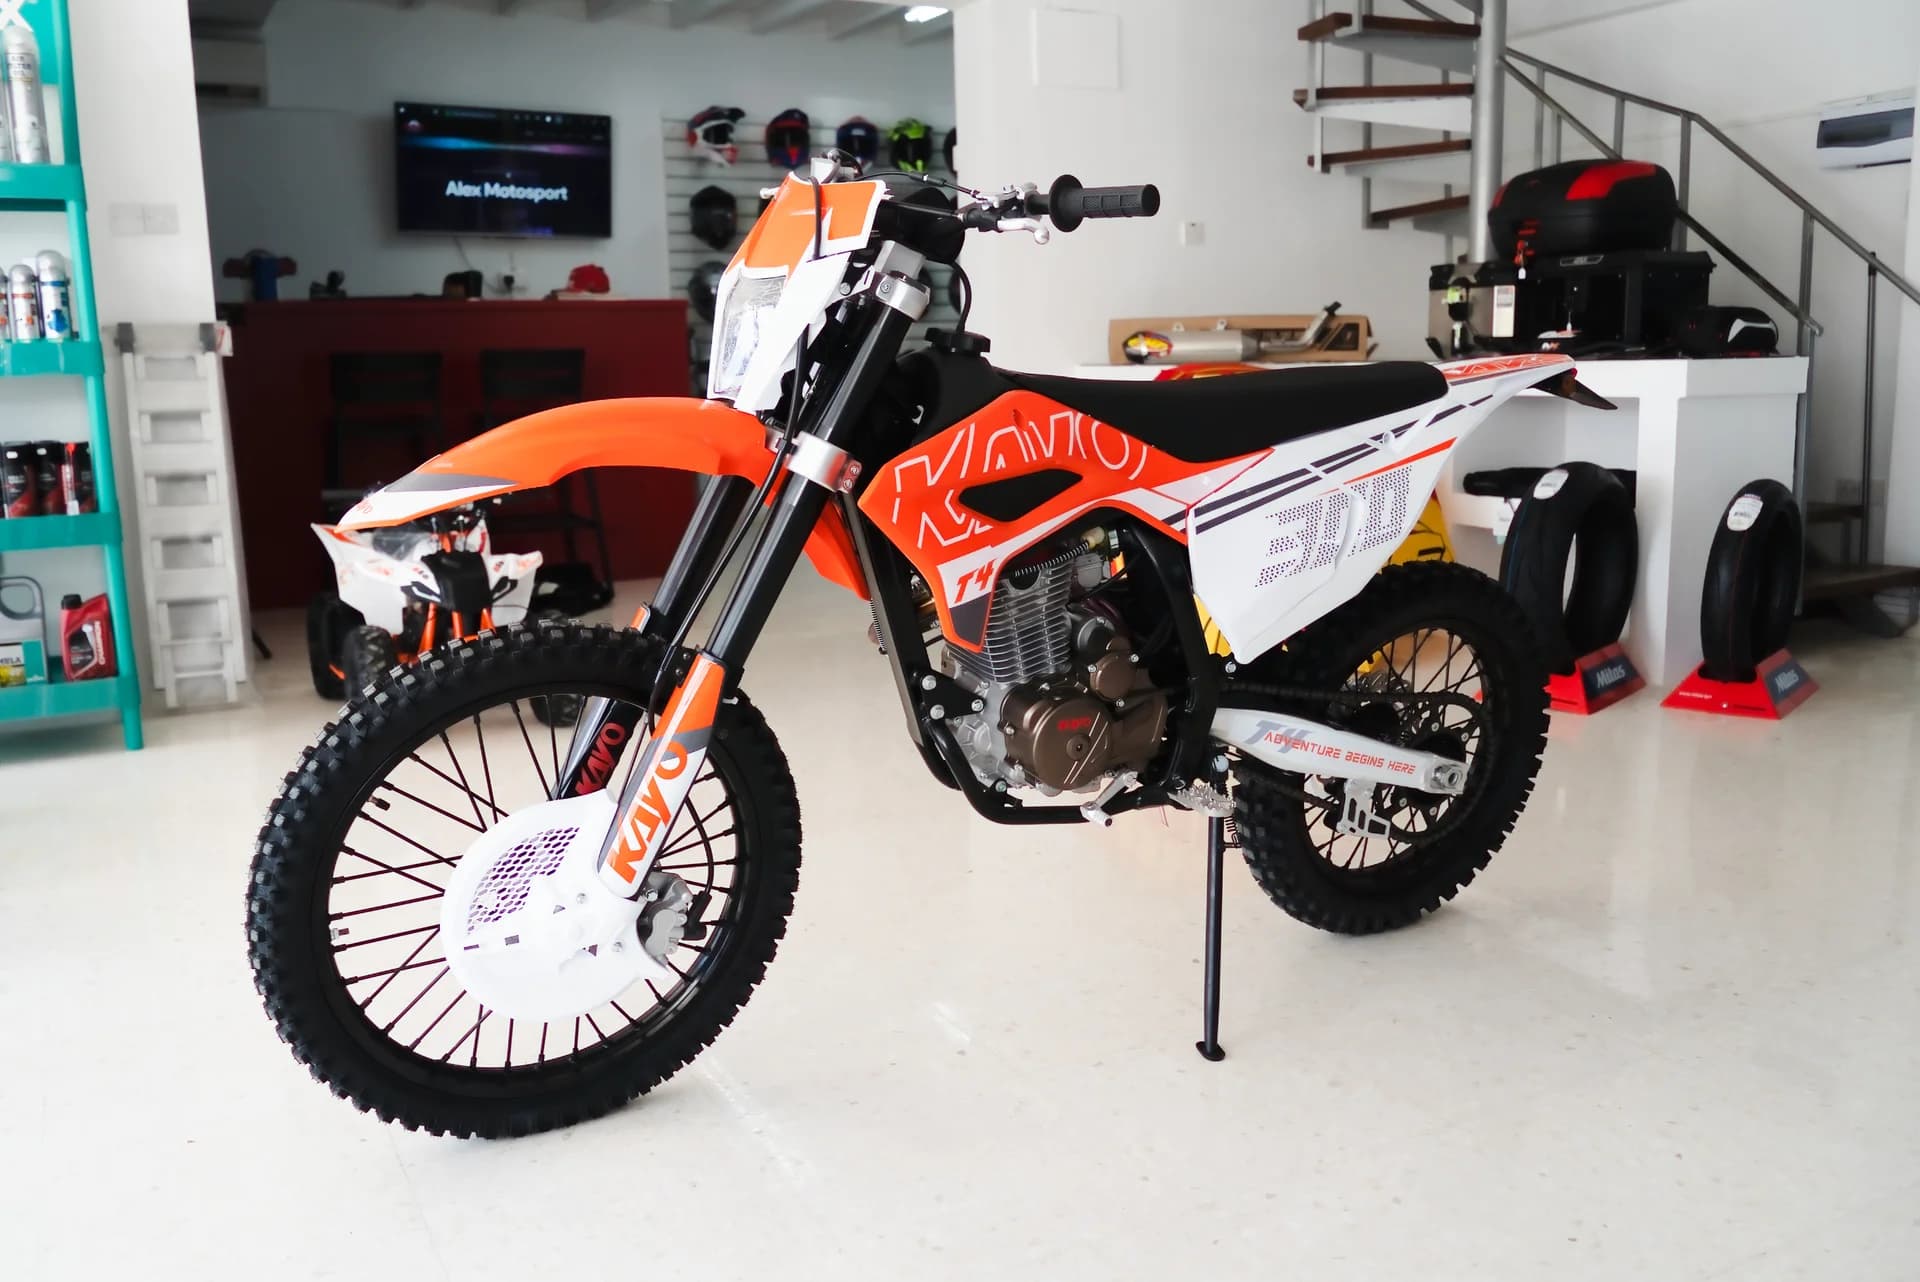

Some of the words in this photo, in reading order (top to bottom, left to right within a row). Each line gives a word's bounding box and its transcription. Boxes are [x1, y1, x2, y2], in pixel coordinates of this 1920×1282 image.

[446, 180, 482, 198] Alex
[484, 182, 569, 203] Motosport
[955, 559, 996, 602] T4
[1263, 731, 1342, 759] ADVENTURE
[1345, 751, 1385, 768] BEGINS
[1387, 762, 1417, 775] HERE
[607, 740, 688, 884] KAYO
